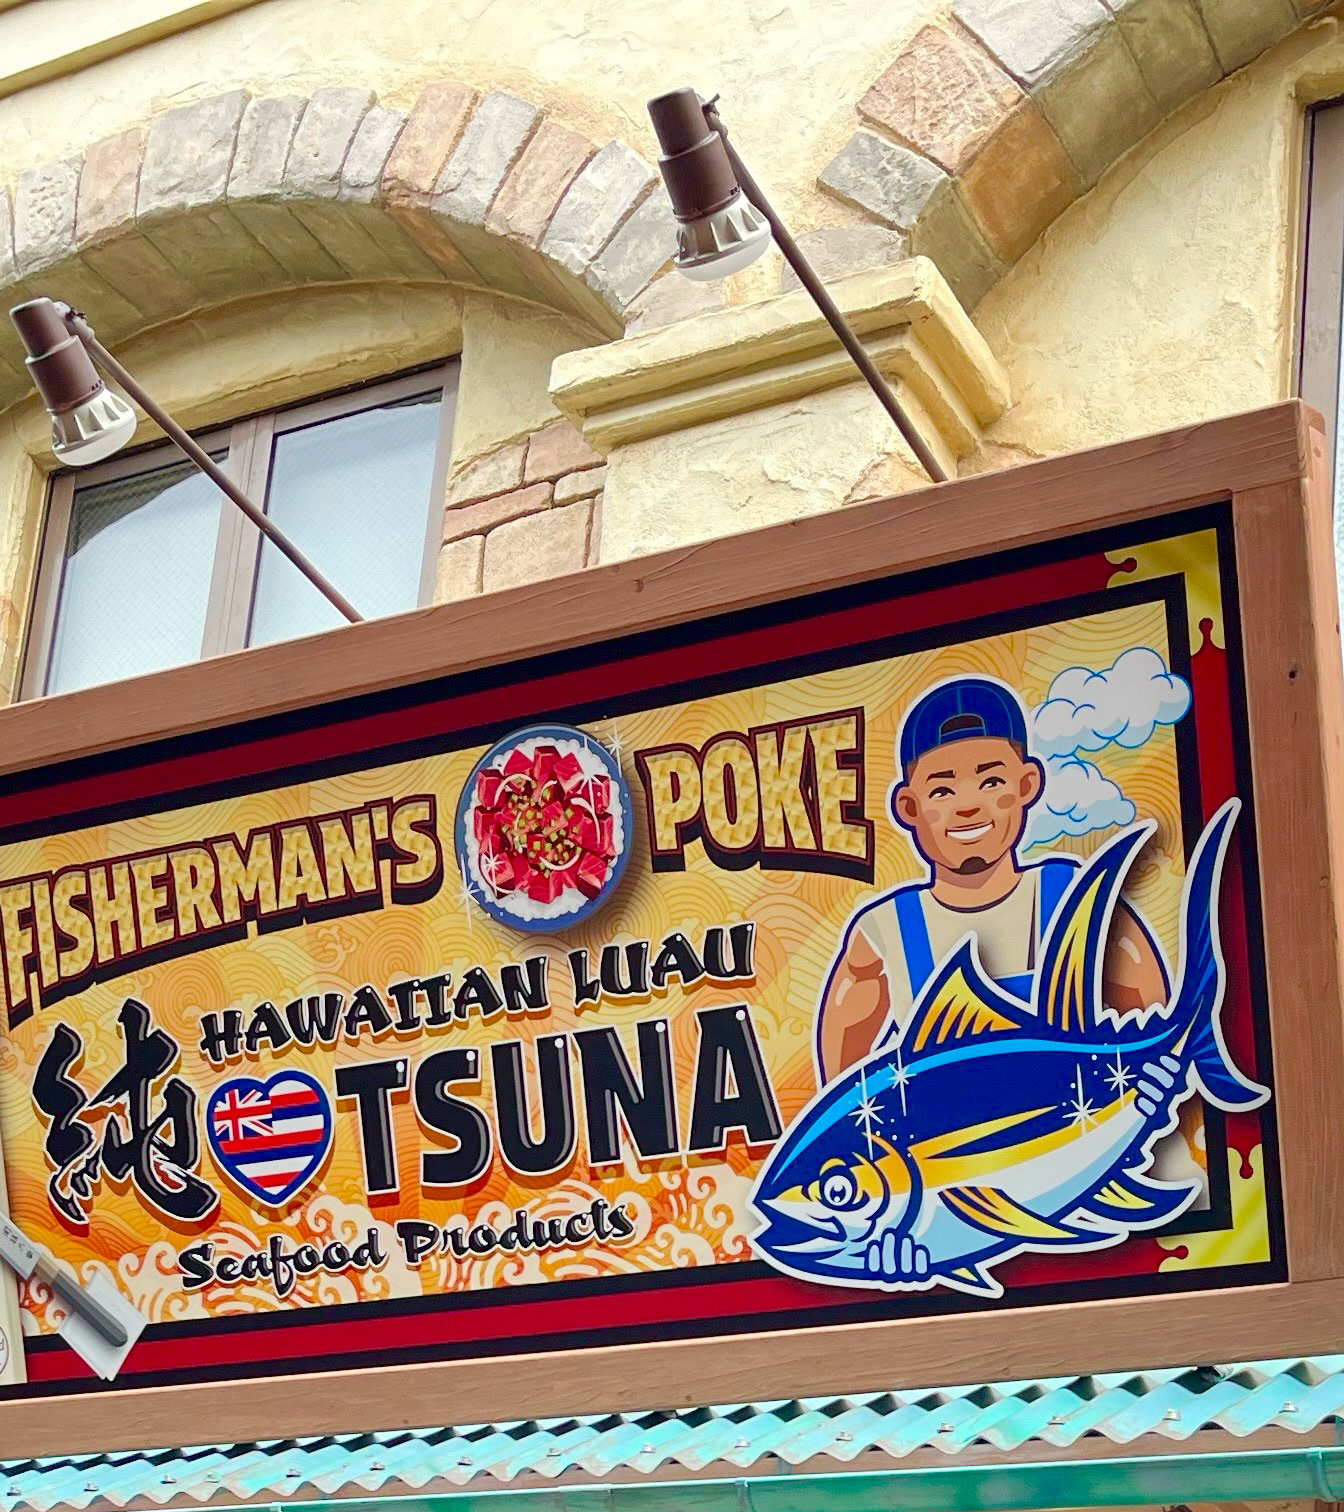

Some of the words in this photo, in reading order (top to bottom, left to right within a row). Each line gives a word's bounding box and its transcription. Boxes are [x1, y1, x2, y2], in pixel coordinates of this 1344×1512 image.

[640, 707, 873, 882] POKE
[200, 956, 548, 1064] HAWAIIAN
[568, 923, 755, 1007] LUAU
[32, 998, 220, 1223] 純
[337, 1005, 782, 1196] TSUNA
[180, 1235, 386, 1297] Seafood
[397, 1198, 637, 1265] Products
